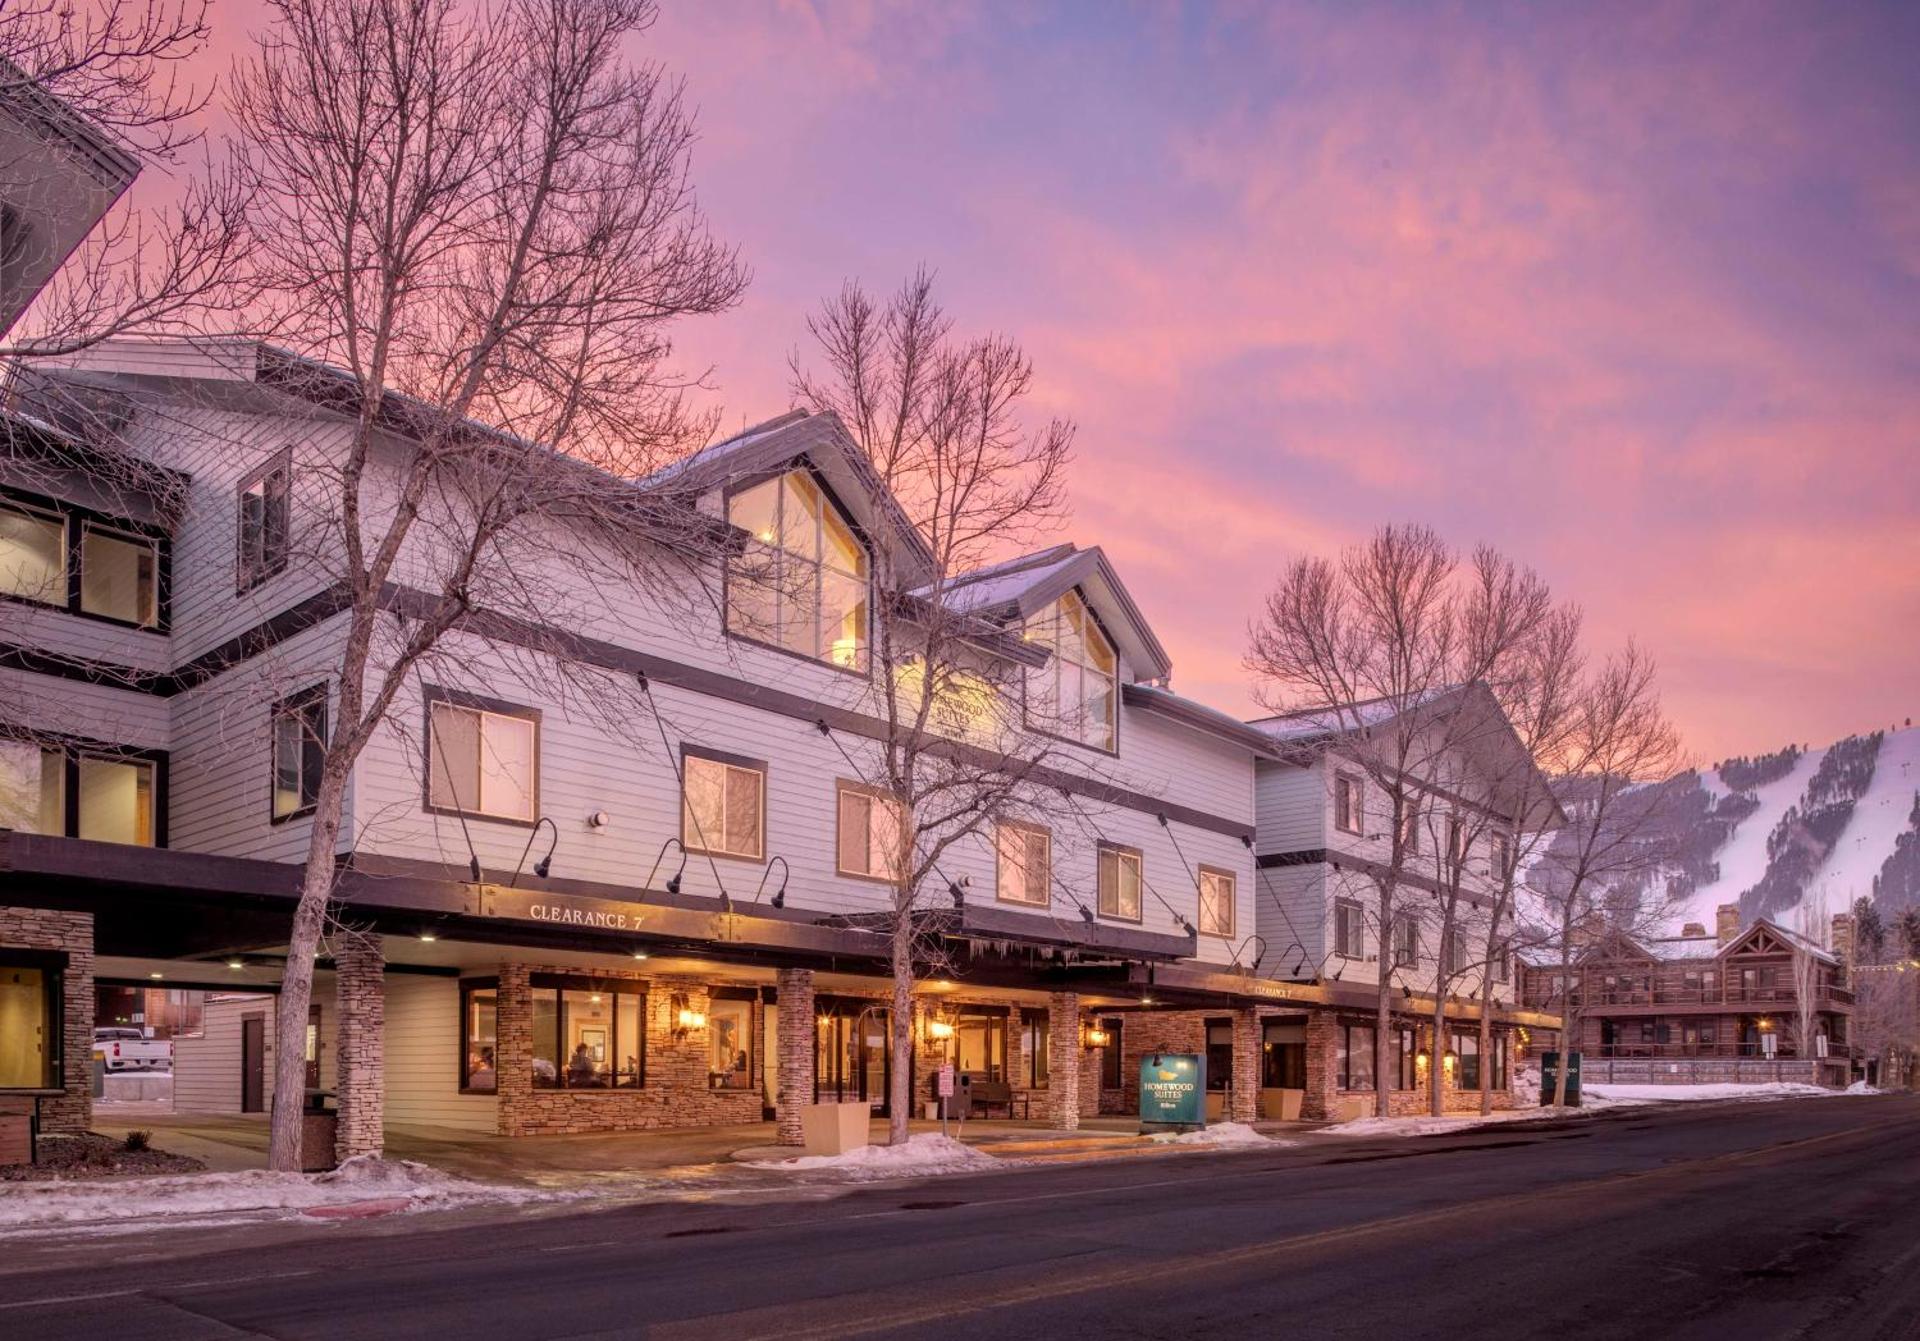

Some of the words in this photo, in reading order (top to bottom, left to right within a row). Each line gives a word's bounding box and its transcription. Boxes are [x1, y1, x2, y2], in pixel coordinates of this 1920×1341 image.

[529, 904, 627, 928] CLEARANCE
[1144, 1082, 1194, 1091] HOMEWOOD
[1154, 1091, 1182, 1099] SUITES
